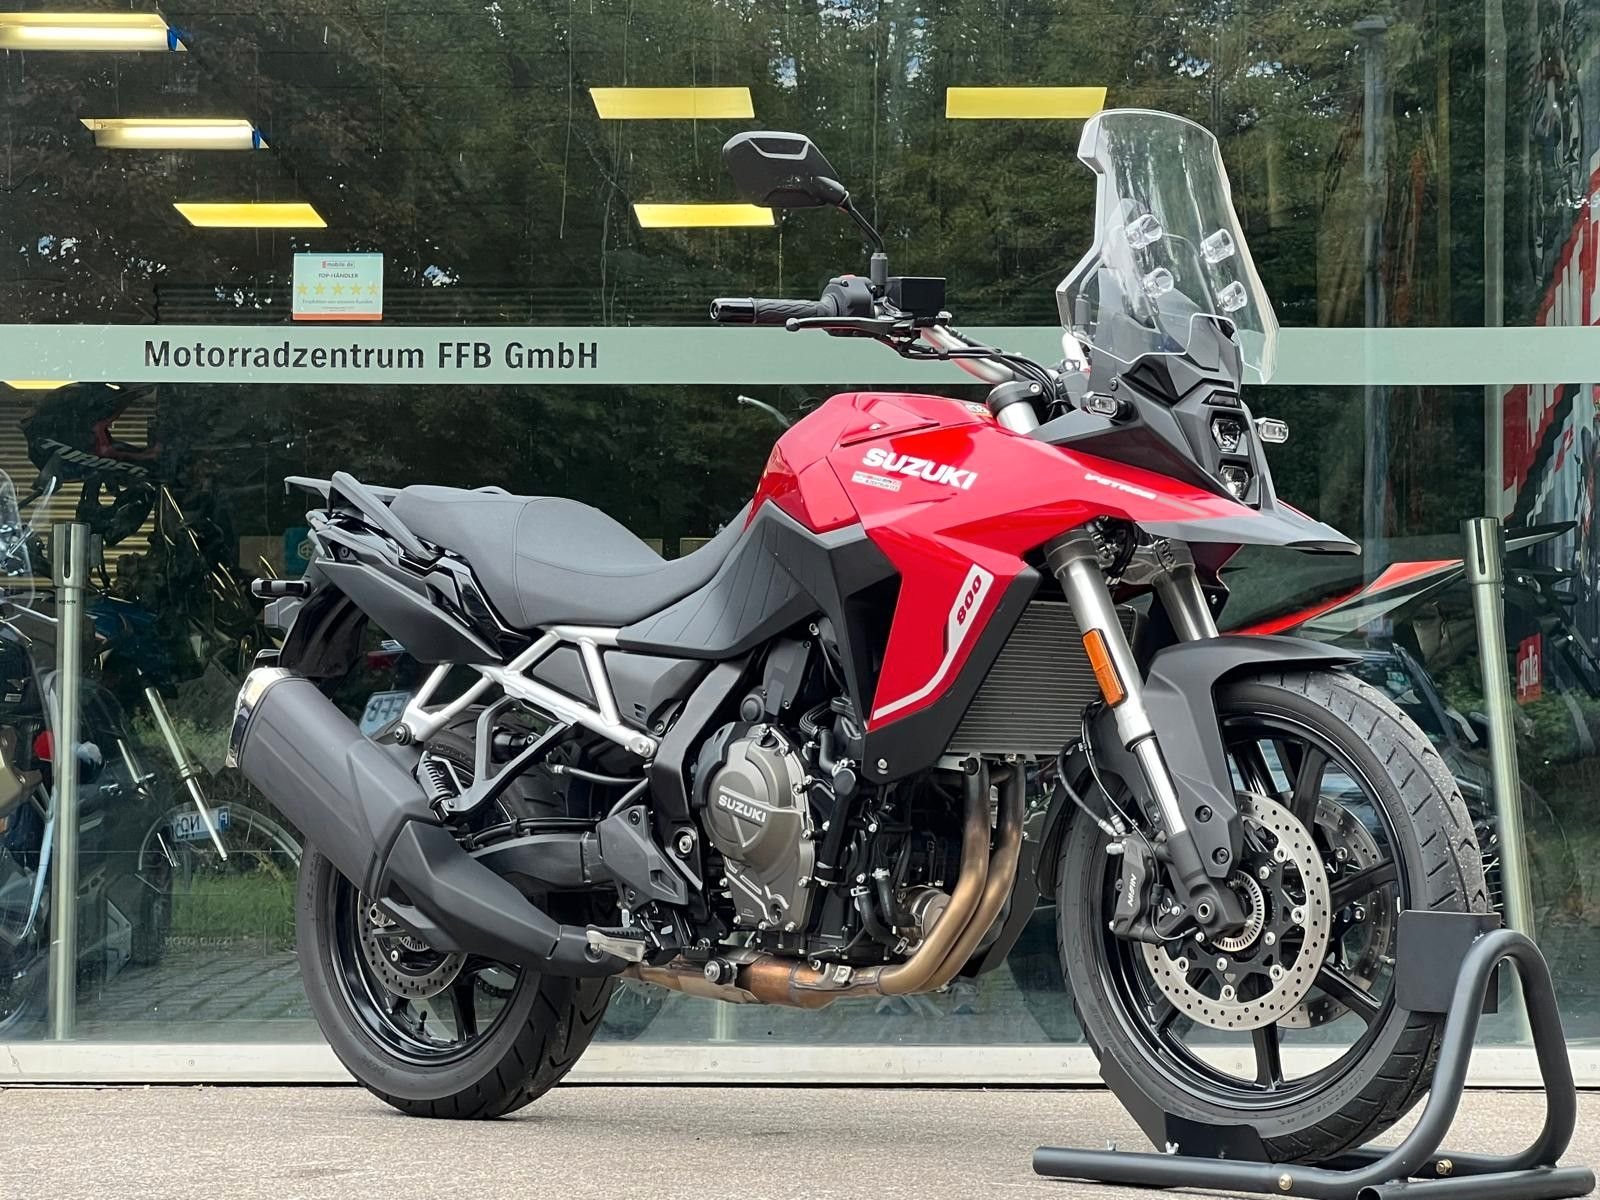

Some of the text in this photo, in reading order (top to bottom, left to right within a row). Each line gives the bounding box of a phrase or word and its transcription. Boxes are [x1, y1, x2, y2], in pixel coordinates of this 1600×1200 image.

[143, 340, 598, 369] Motorradzentrum FFB GmbH
[862, 447, 979, 490] SUZUKI
[957, 575, 982, 626] 800
[718, 794, 768, 823] SUZUKI
